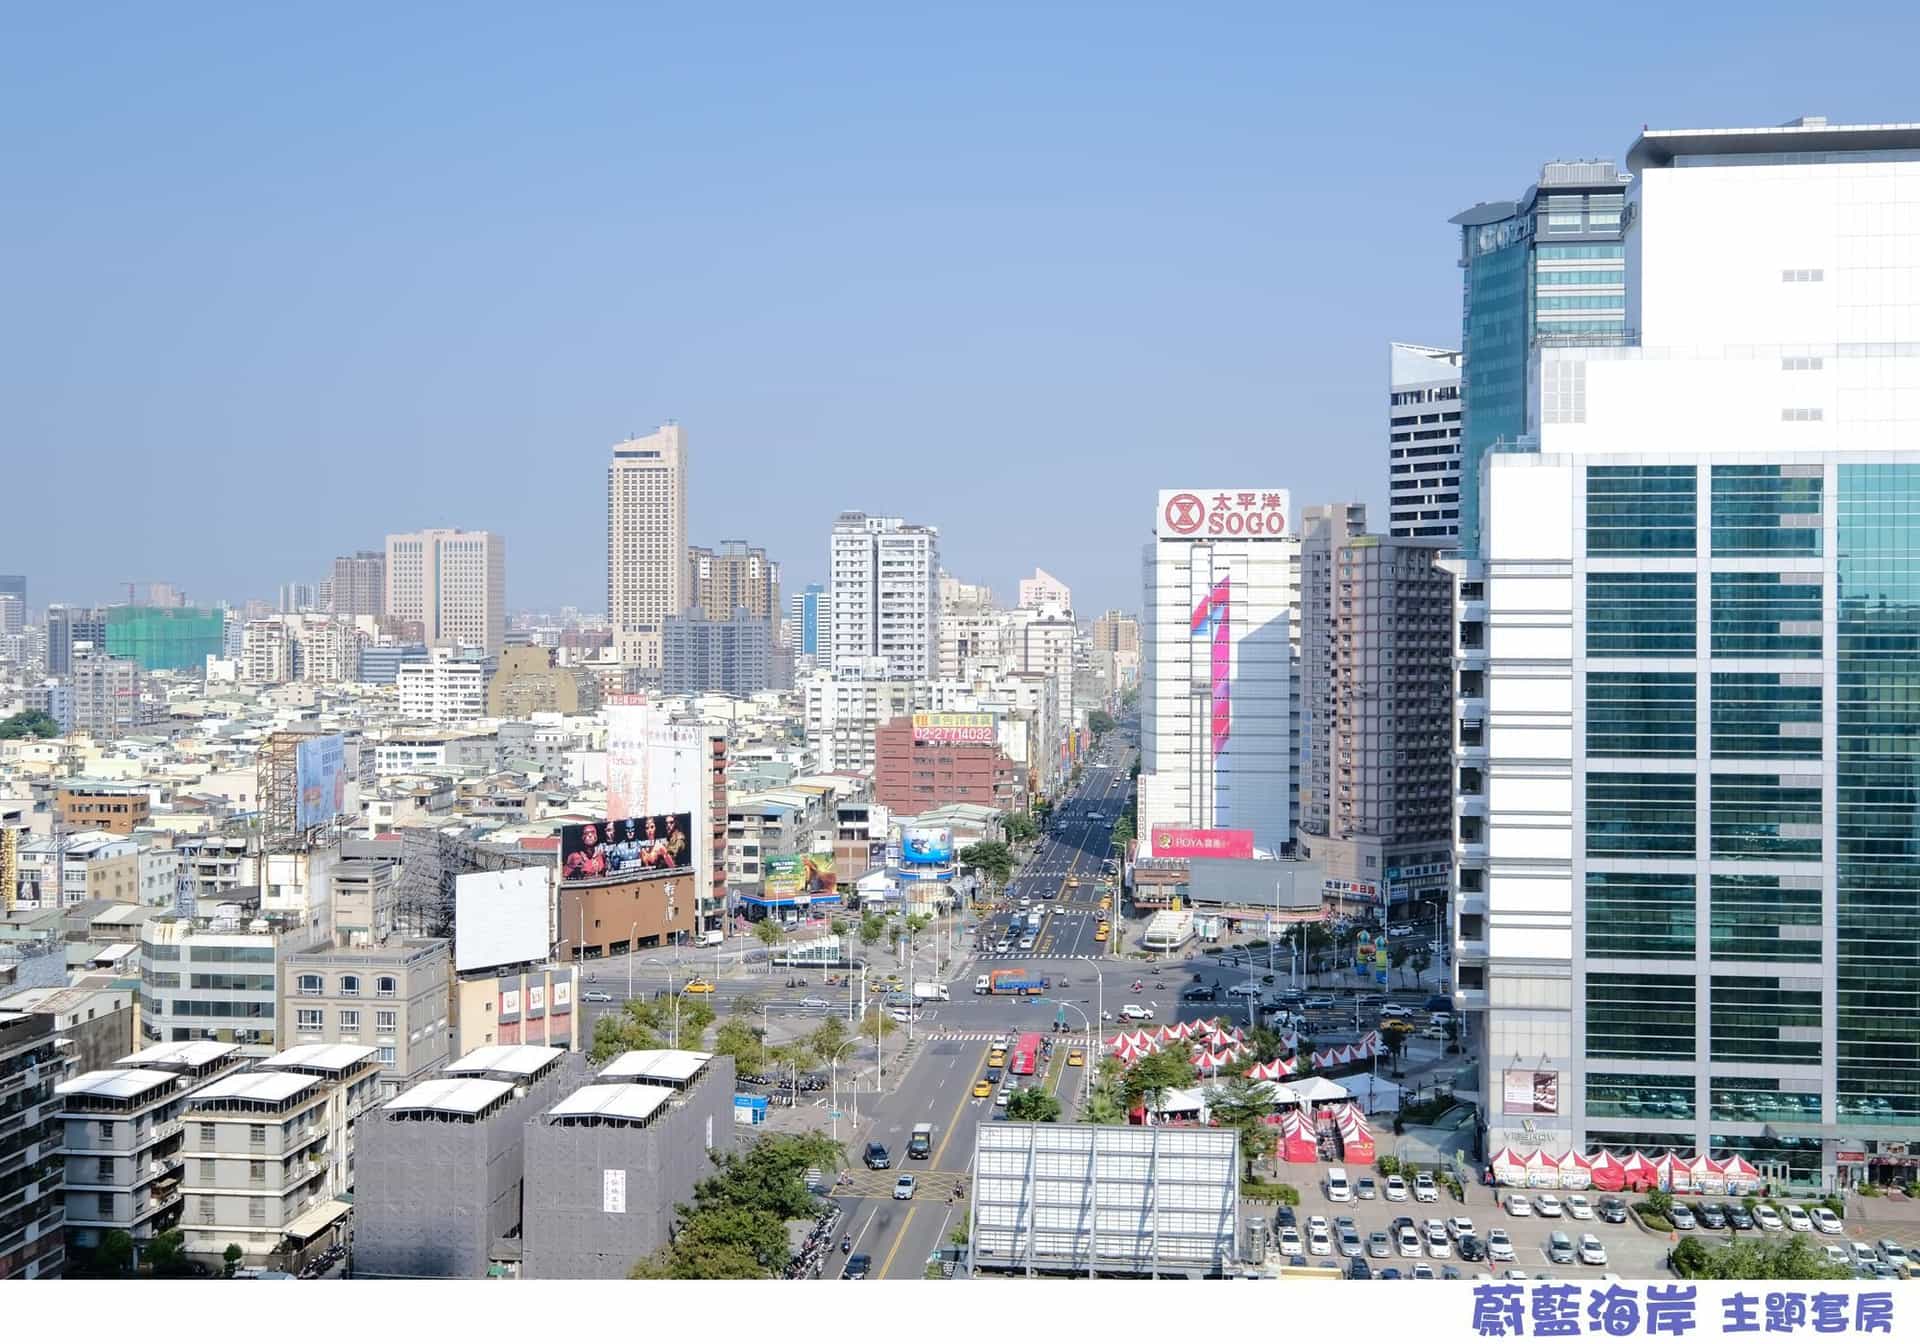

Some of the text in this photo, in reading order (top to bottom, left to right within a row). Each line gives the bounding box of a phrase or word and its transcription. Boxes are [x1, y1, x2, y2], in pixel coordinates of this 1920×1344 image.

[1212, 493, 1281, 511] 太平洋
[1208, 512, 1285, 535] SOGO
[914, 727, 993, 740] 02-27714032
